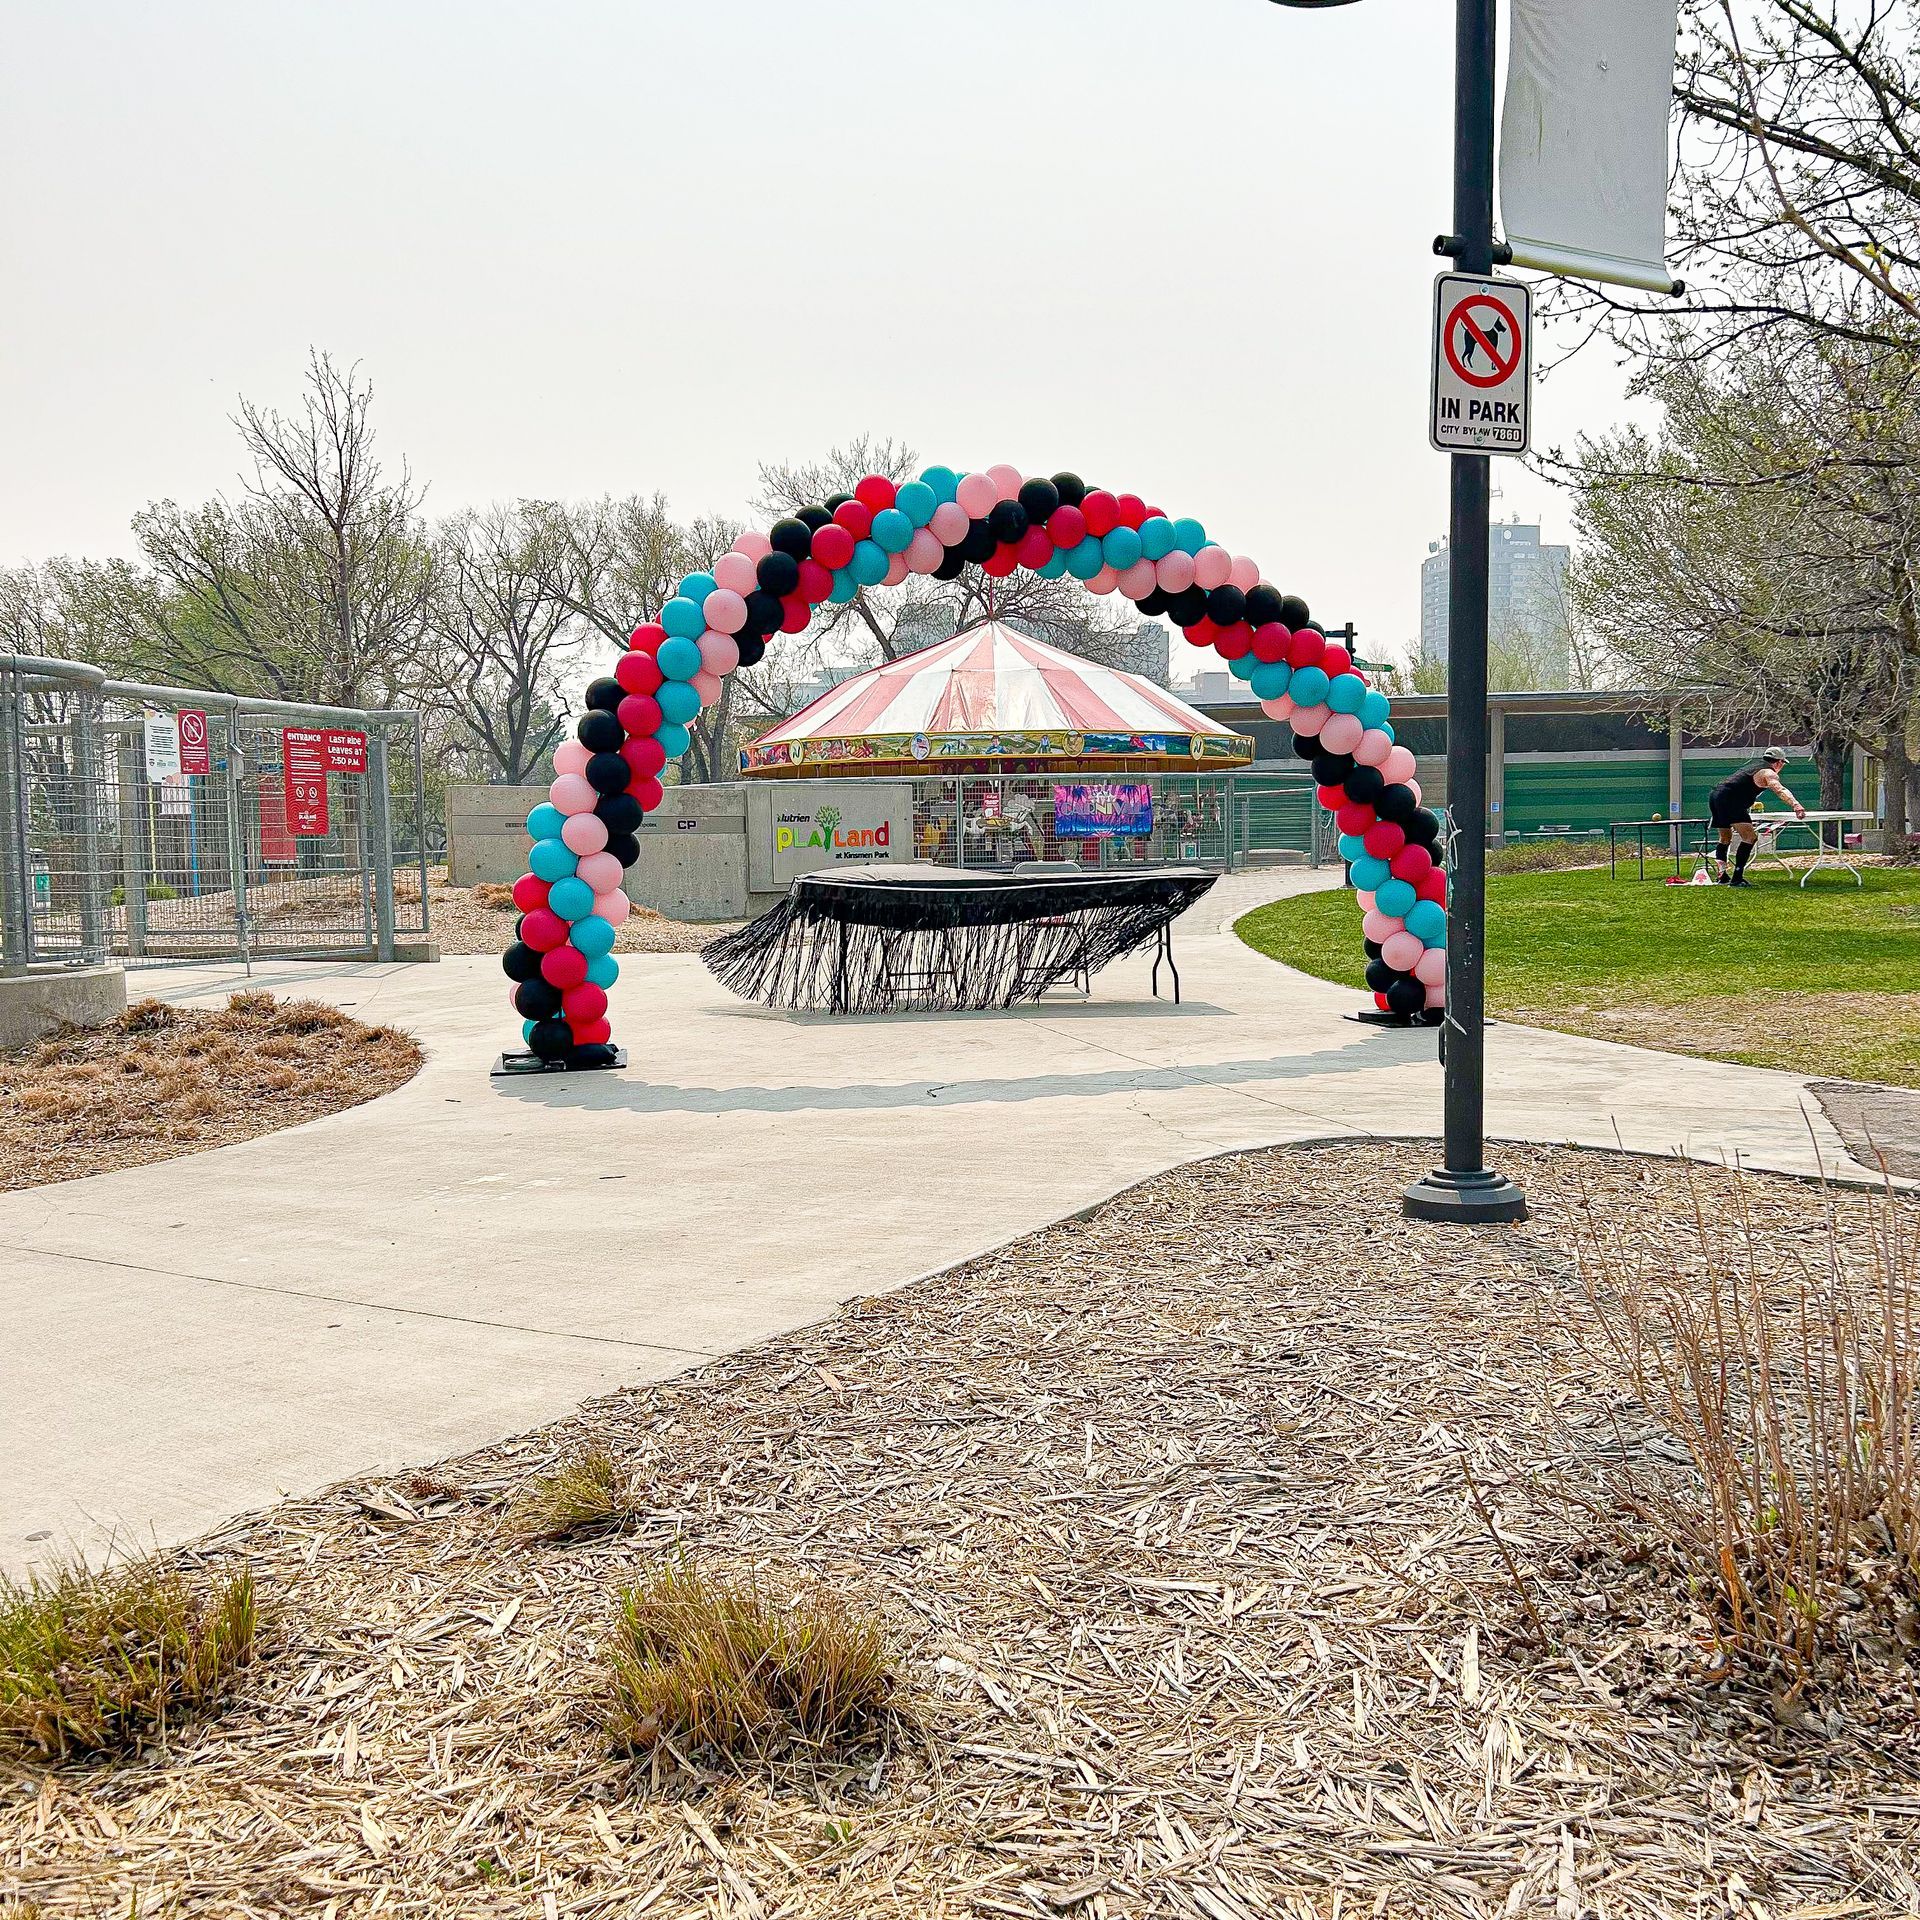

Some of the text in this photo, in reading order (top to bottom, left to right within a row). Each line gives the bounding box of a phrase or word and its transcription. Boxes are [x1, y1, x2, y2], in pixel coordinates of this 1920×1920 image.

[1441, 397, 1520, 424] IN PARK
[1441, 424, 1460, 435] CITY
[1493, 428, 1520, 441] 7860
[677, 820, 697, 830] CP
[843, 851, 873, 859] Kinsmen
[874, 851, 890, 859] Park
